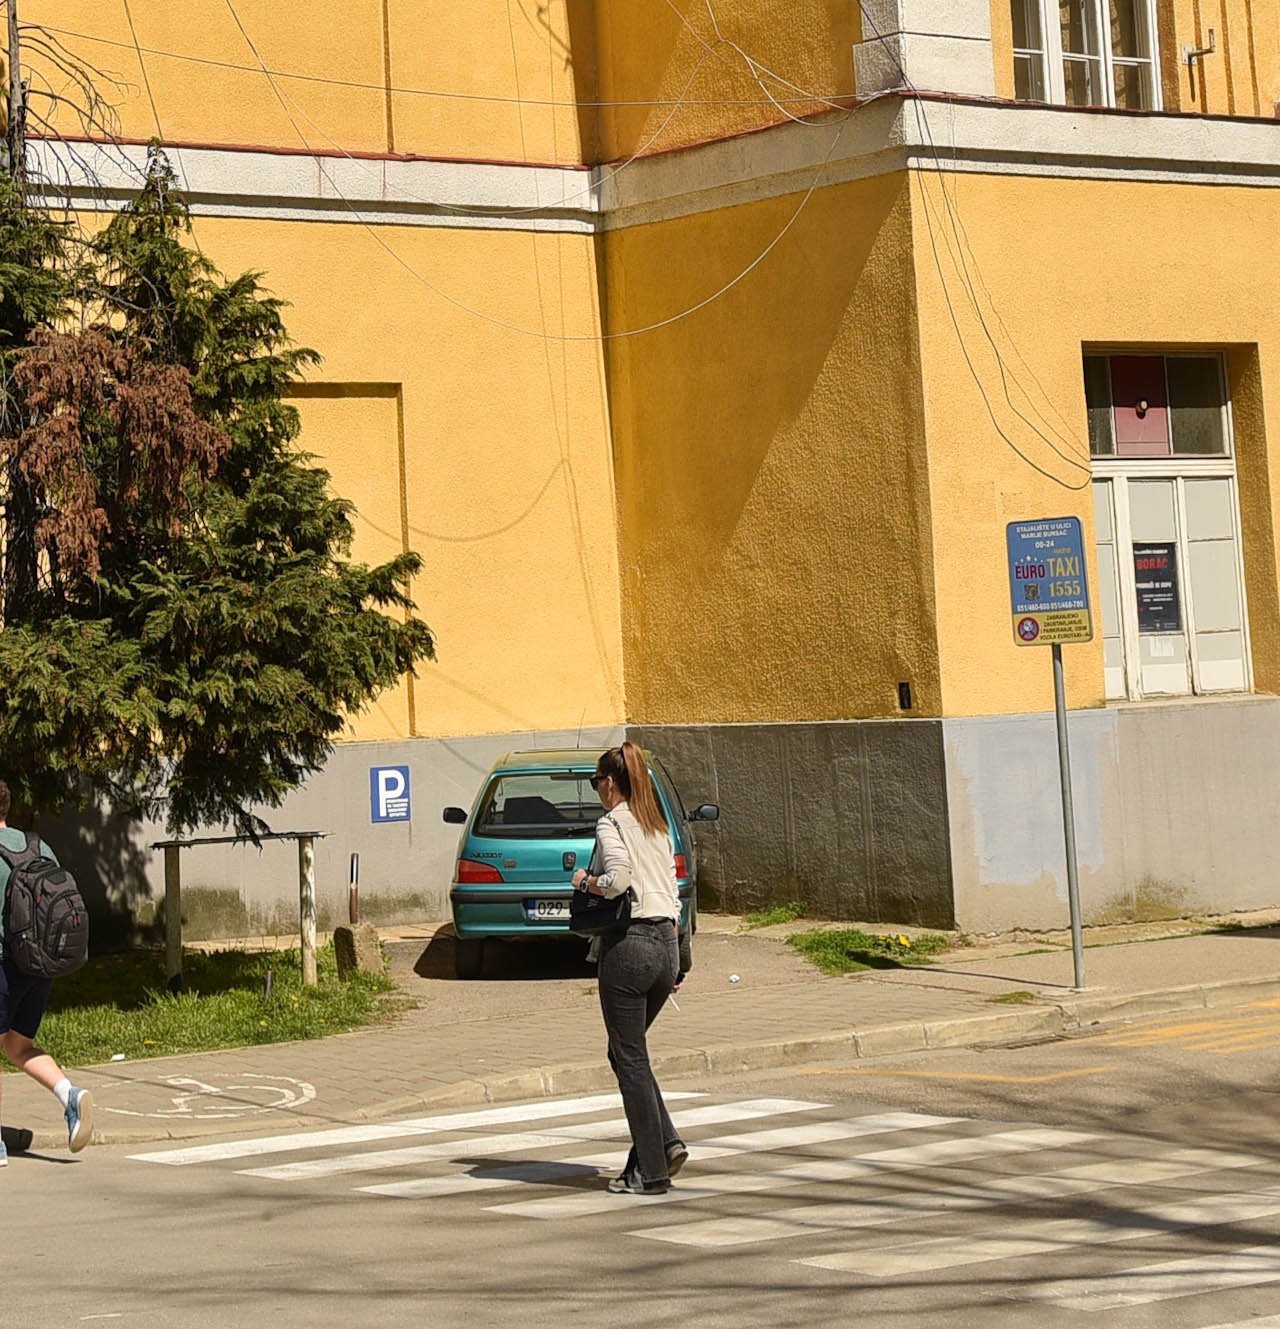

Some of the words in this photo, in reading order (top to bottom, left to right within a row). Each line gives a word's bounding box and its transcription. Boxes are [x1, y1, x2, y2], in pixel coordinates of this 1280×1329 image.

[1035, 540, 1055, 549] 00-24
[1015, 564, 1046, 580] EURO
[1046, 556, 1081, 577] TAXI
[1137, 558, 1169, 570] BORAC
[1049, 579, 1081, 597] 1555
[378, 770, 405, 817] P
